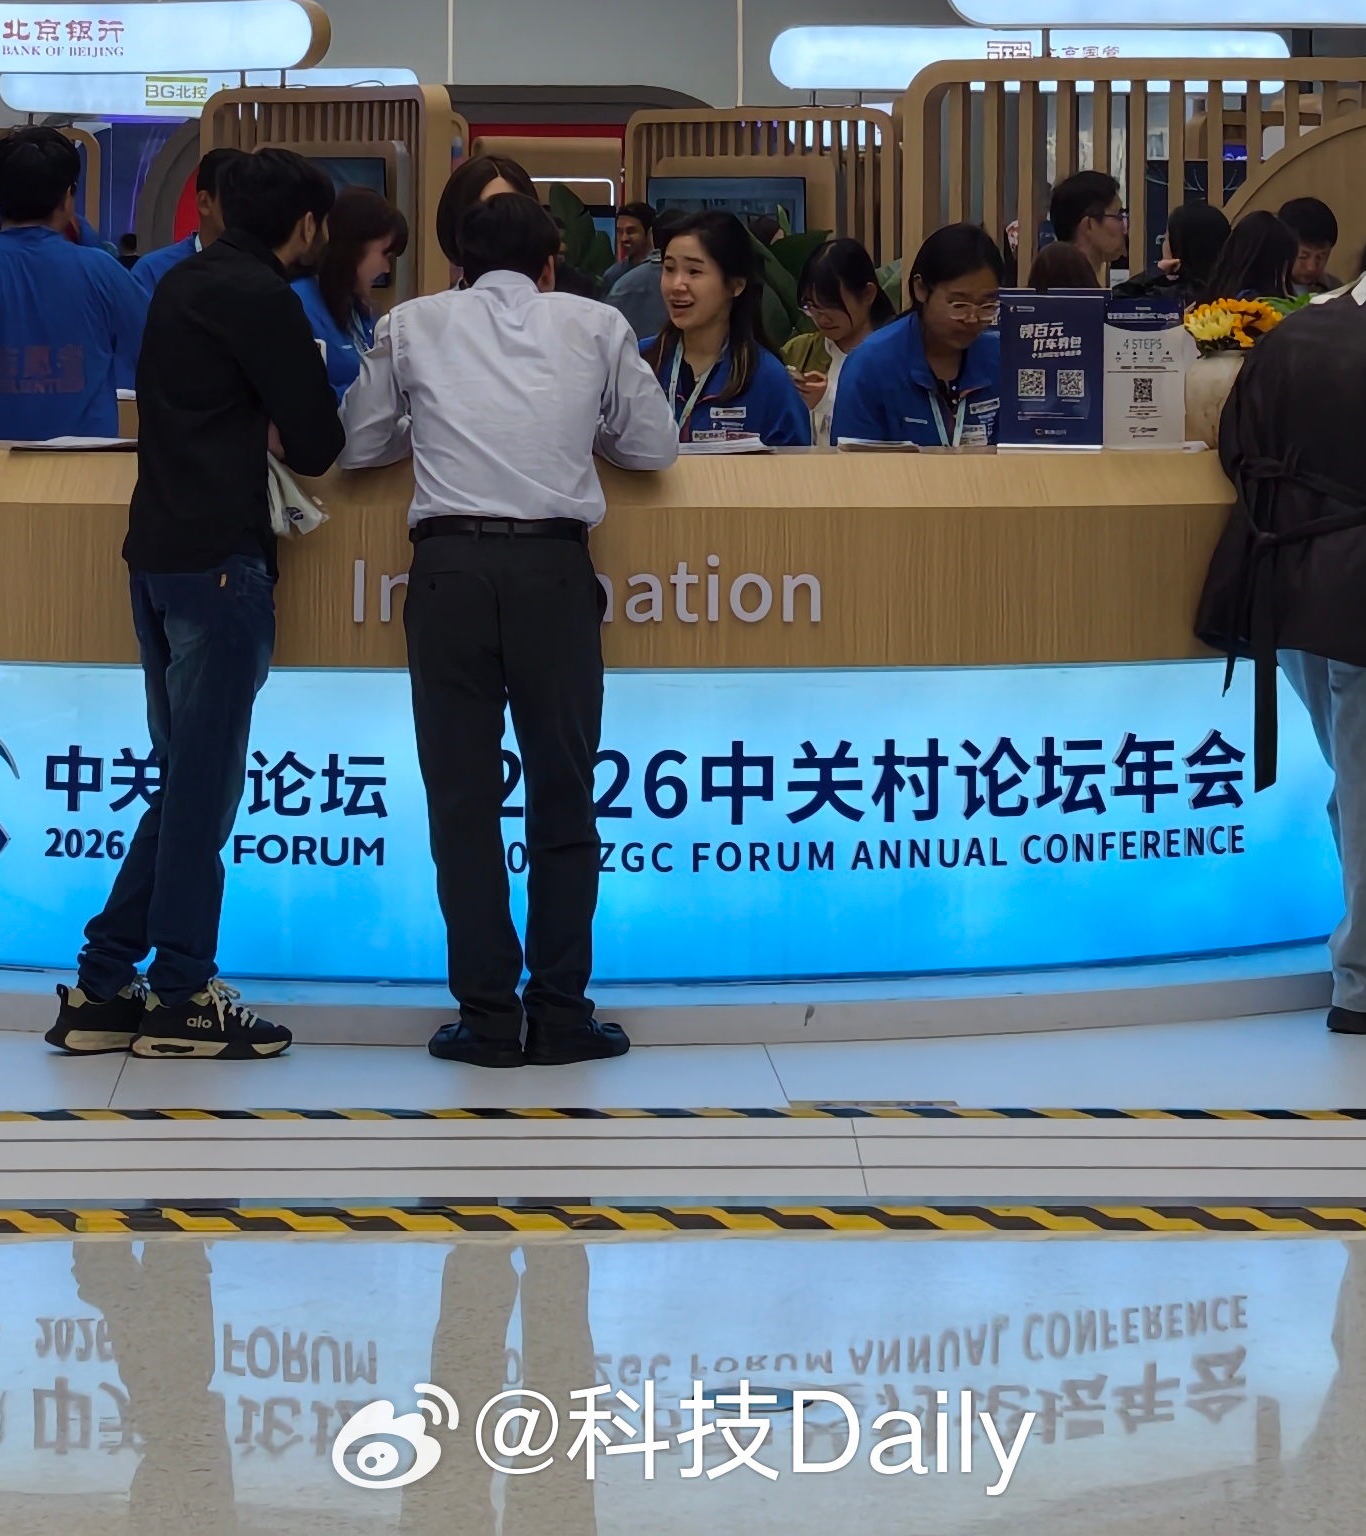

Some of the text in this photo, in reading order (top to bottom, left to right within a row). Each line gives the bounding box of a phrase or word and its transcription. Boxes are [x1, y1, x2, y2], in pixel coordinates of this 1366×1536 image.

[2, 45, 125, 58] BANK OF BEIJING
[45, 728, 1246, 826] 中关论坛 226中关村论坛年会
[44, 827, 385, 867] 2026 FORUM
[599, 824, 1246, 873] ZGC FORUM ANNUAL CONFERENCE
[186, 1015, 213, 1029] alo
